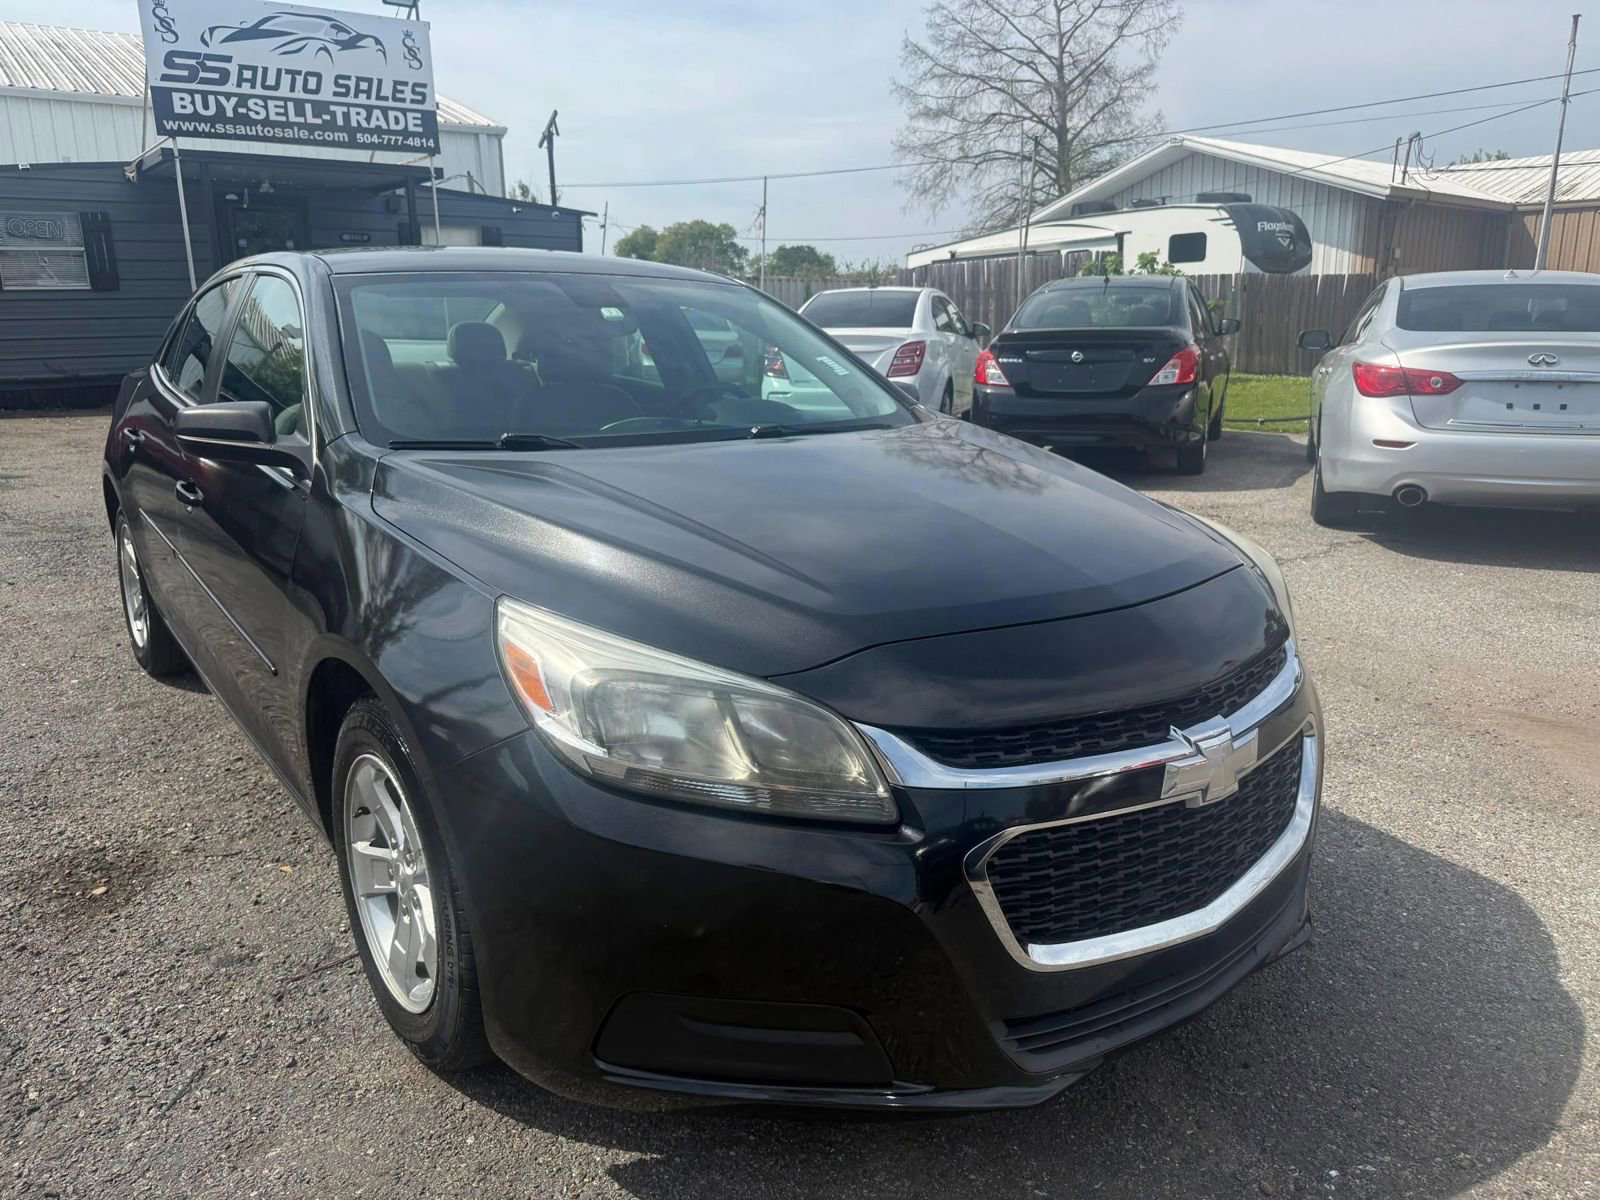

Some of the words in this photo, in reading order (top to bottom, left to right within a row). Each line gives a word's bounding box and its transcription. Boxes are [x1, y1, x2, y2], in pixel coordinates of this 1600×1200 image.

[160, 49, 233, 86] SS
[236, 63, 323, 95] AUTO
[332, 74, 428, 105] SALES
[171, 91, 424, 133] BUY-SELL-TRADE
[163, 119, 348, 143] www.ssautosale.com
[356, 132, 435, 148] 504-777-4814
[8, 218, 64, 238] OPEN
